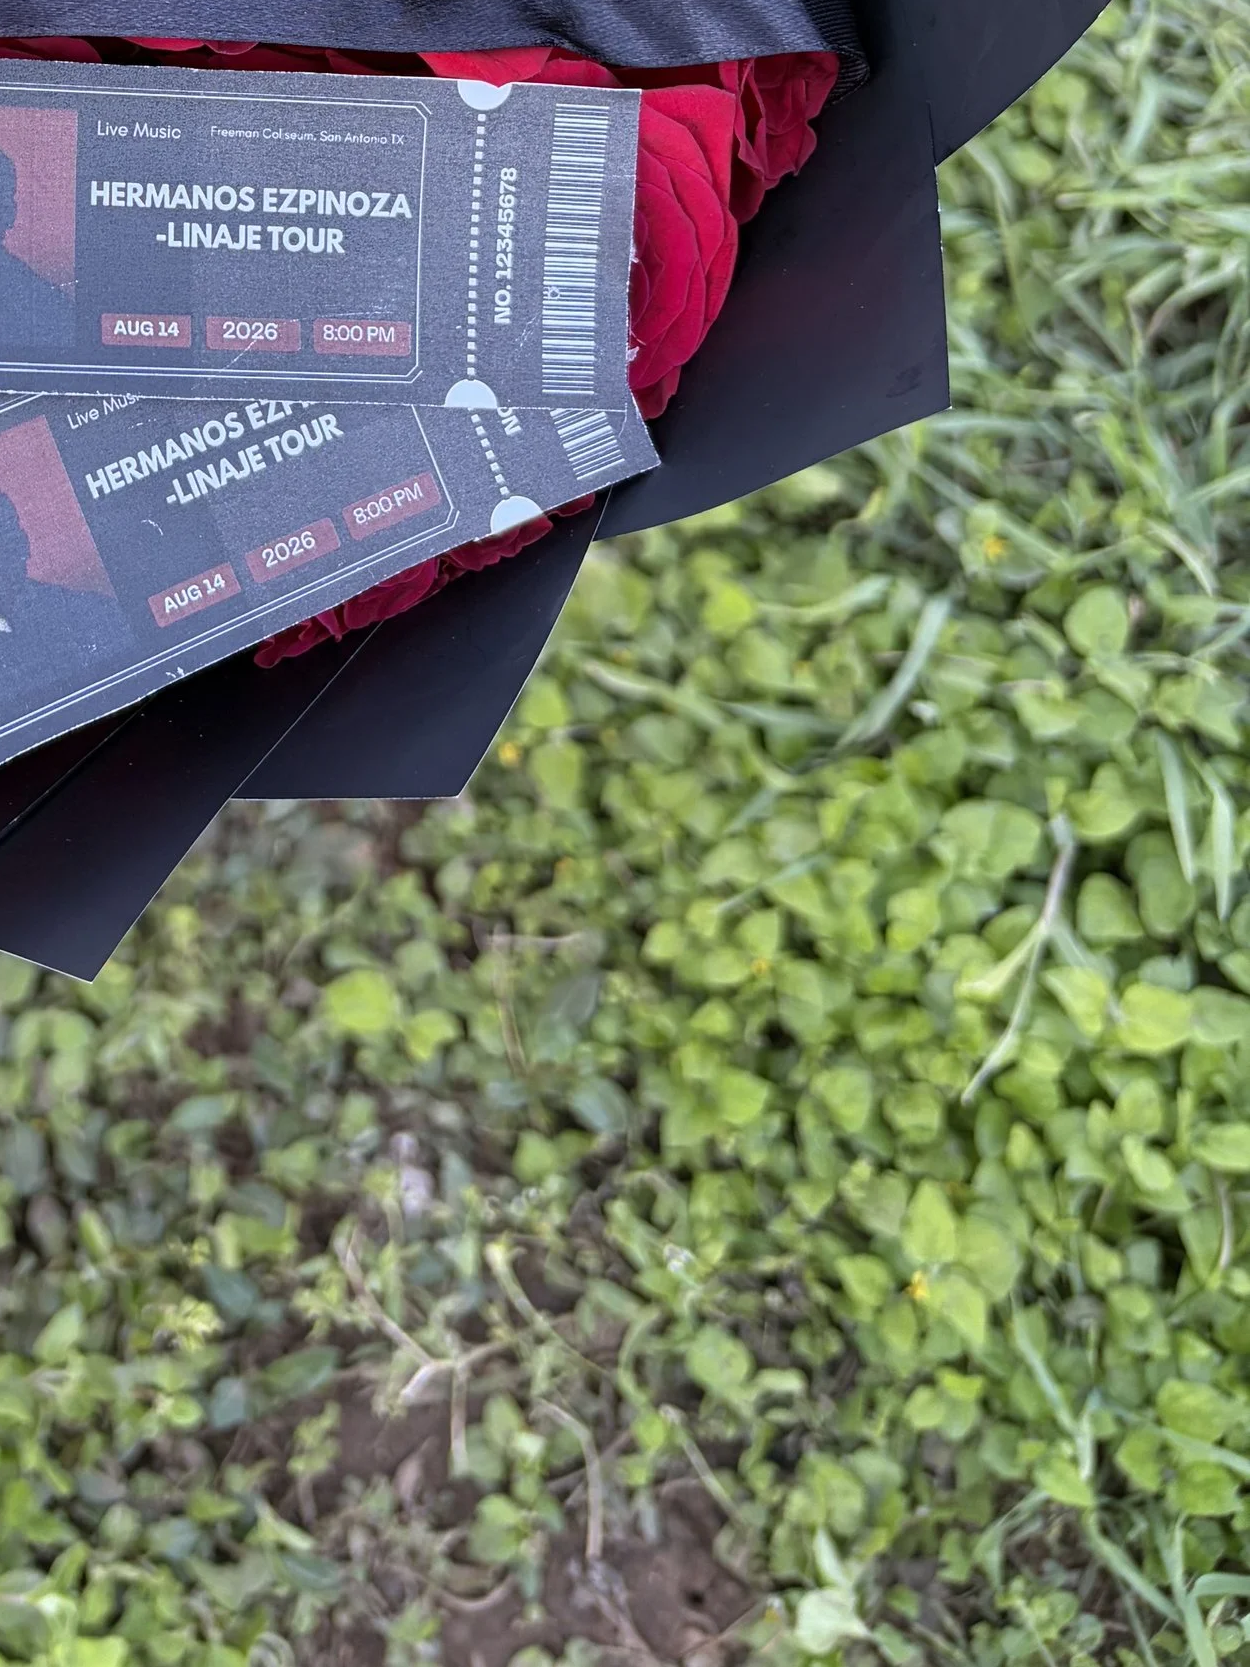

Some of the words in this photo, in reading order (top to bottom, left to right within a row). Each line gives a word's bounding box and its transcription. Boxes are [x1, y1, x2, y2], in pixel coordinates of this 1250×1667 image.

[97, 120, 129, 137] Live
[133, 121, 182, 139] Music
[210, 125, 260, 139] Freeman
[262, 127, 317, 142] Colseum,
[319, 130, 342, 143] San
[344, 132, 388, 145] Antonio
[390, 134, 405, 145] TX
[90, 180, 255, 212] HERMANOS
[262, 187, 413, 219] EZPINOZA
[155, 221, 262, 250] -LINAJE
[266, 225, 346, 254] TOUR
[495, 167, 518, 280] 12345678
[494, 285, 513, 325] NO.
[113, 320, 154, 336] AUG
[158, 321, 180, 337] 14
[222, 321, 278, 341] 2026
[322, 323, 363, 343] 8:00
[366, 326, 396, 343] PM
[66, 407, 100, 430] Live
[102, 392, 141, 415] Mus
[85, 411, 245, 499] HERMANOS
[165, 444, 267, 505] -LINAJE
[263, 413, 345, 463] TOUR
[353, 495, 393, 525] 8:00
[394, 482, 424, 507] PM
[261, 530, 317, 568] 2026
[163, 583, 203, 613] AUG
[203, 573, 226, 596] 14
